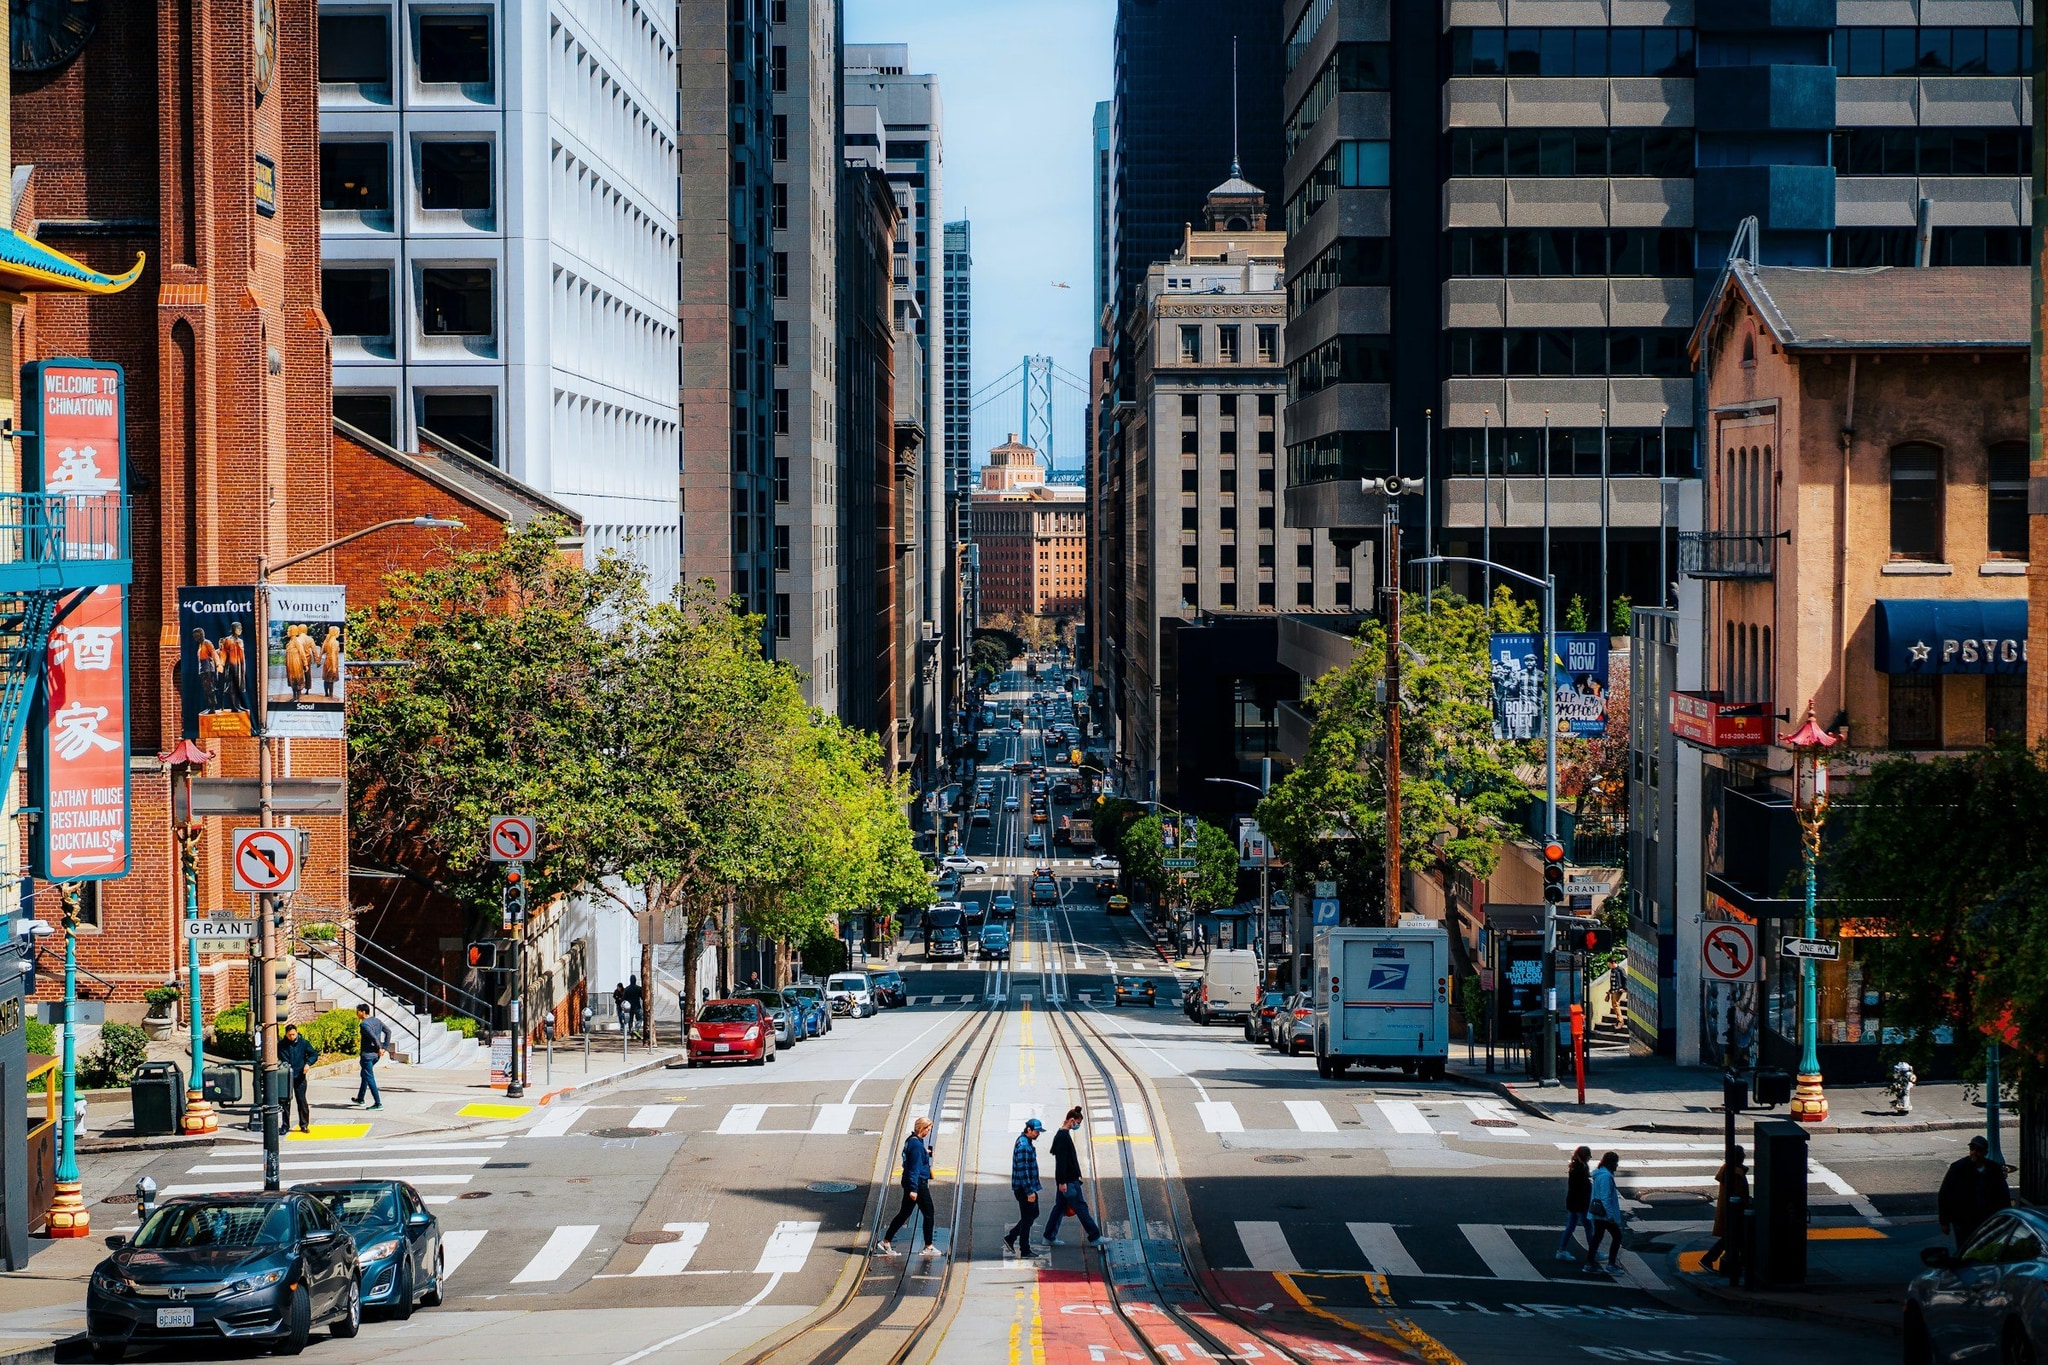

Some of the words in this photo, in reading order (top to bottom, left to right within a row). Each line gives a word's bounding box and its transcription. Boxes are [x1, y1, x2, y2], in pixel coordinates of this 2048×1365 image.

[45, 375, 97, 394] WELCOME
[102, 378, 116, 394] TO
[48, 397, 113, 416] CHINATOWN
[1569, 642, 1596, 656] BOLD
[1569, 656, 1596, 670] NOW
[1505, 700, 1532, 714] BOLD
[1584, 696, 1599, 707] END
[1555, 703, 1599, 716] OMOPHOBIA
[1505, 714, 1533, 728] THEN
[51, 789, 88, 808] CATHAY
[91, 787, 124, 805] HOUSE
[51, 809, 123, 829] RESTAURANT
[51, 830, 110, 851] COCKTAILS
[1567, 885, 1601, 893] GRANT
[190, 923, 252, 935] GRANT
[1799, 943, 1815, 952] ONE
